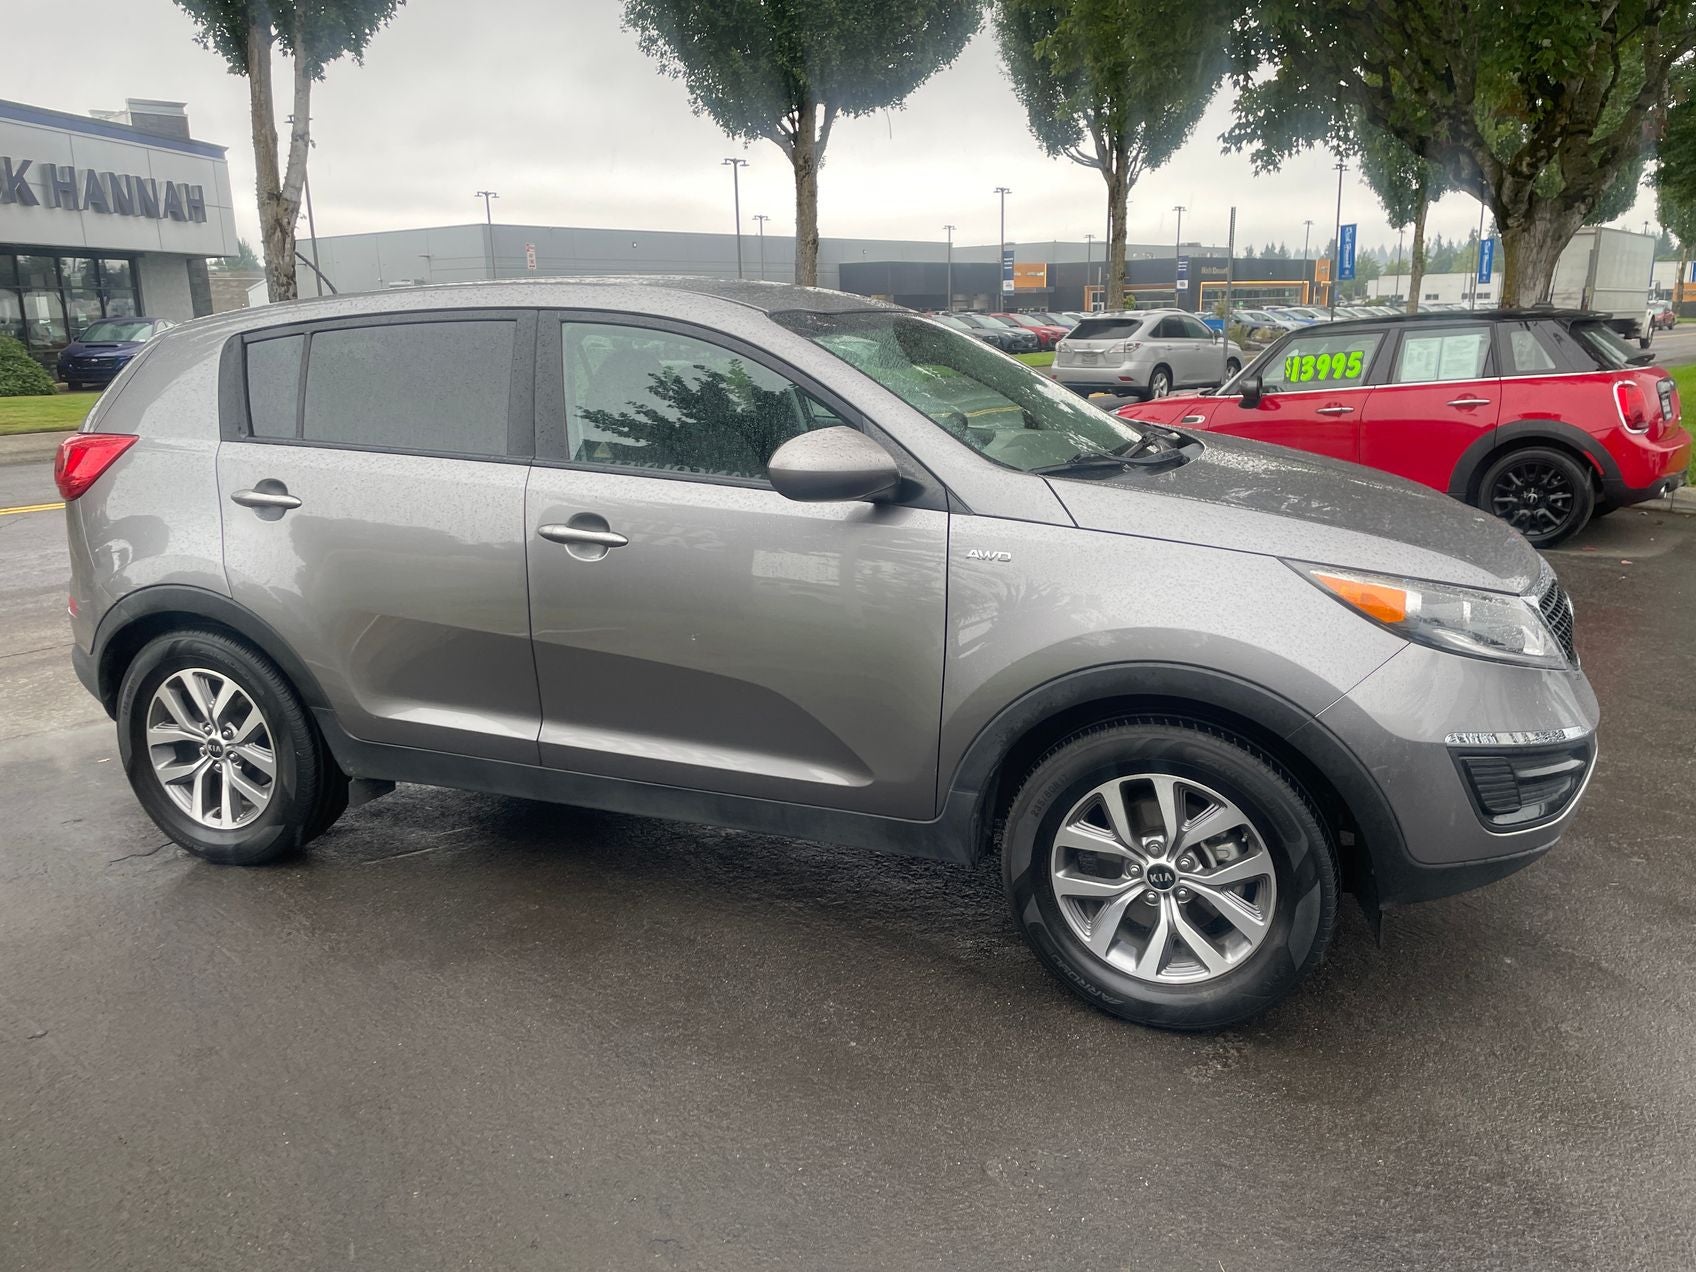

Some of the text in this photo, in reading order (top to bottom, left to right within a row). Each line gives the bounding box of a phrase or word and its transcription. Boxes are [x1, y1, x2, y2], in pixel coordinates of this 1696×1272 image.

[42, 162, 207, 223] HANNAH
[1284, 350, 1364, 384] $13995
[966, 549, 1012, 562] AWD
[208, 744, 222, 752] KIA
[1149, 872, 1173, 883] KIA
